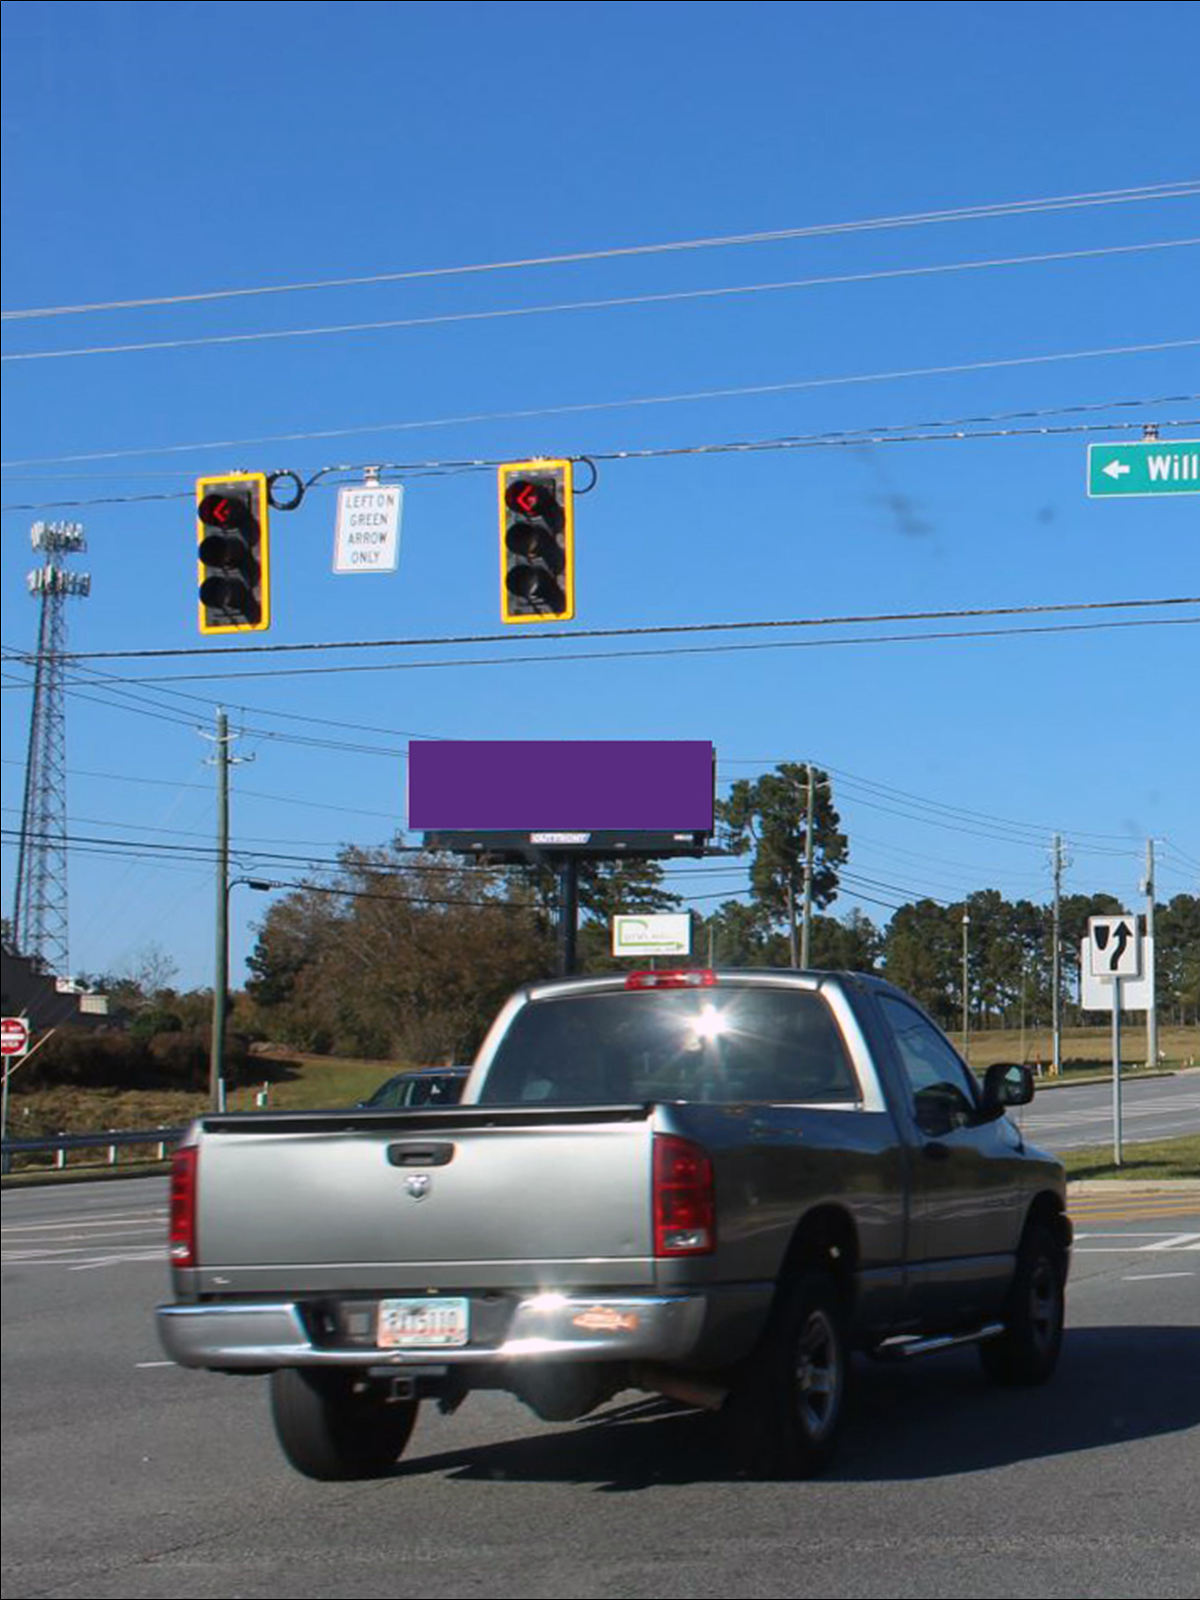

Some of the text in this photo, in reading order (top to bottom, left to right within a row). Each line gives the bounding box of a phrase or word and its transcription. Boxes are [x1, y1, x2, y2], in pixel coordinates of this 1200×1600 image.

[345, 493, 395, 509] LEFT ON
[349, 512, 388, 527] GREEN
[348, 531, 388, 545] ARROW
[352, 551, 382, 564] ONLY
